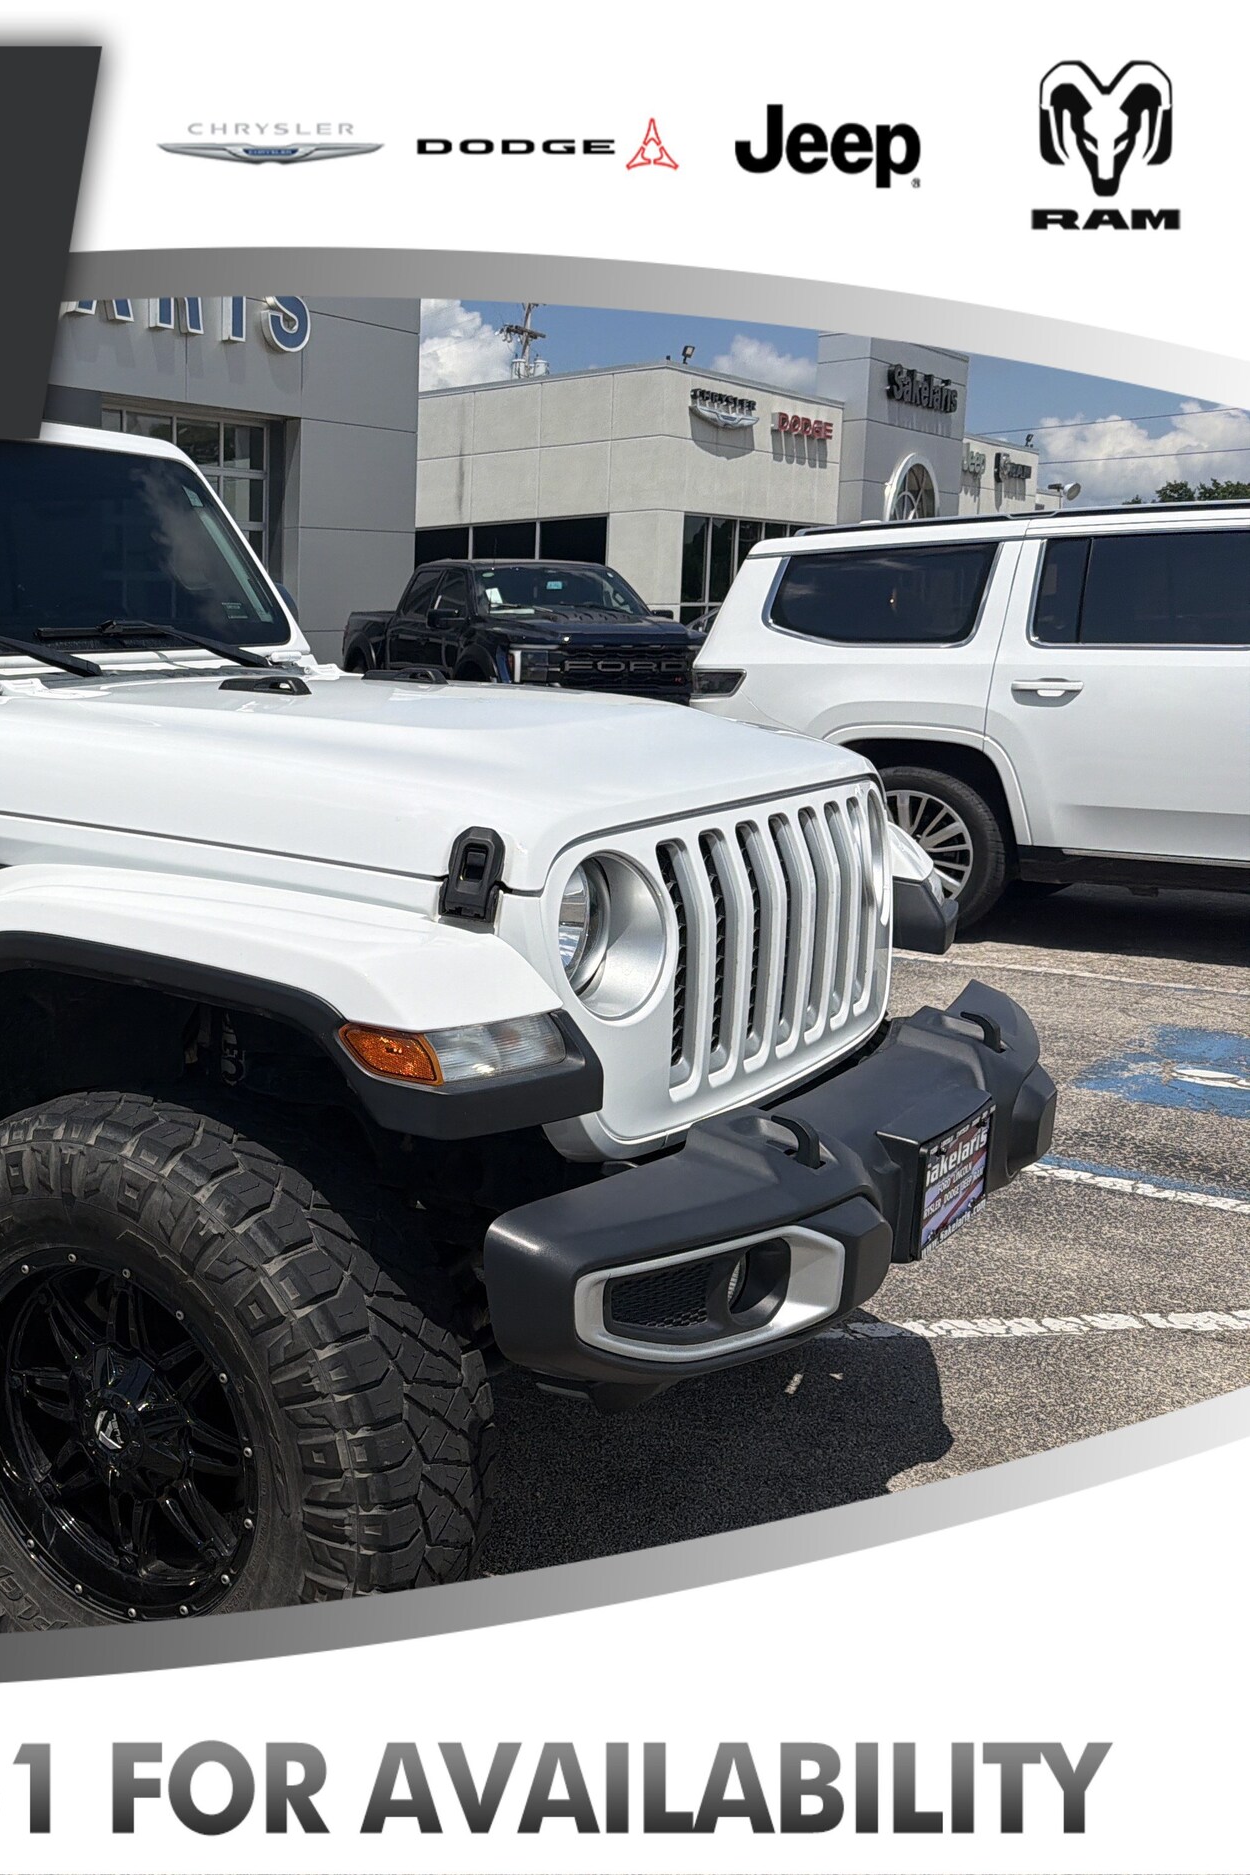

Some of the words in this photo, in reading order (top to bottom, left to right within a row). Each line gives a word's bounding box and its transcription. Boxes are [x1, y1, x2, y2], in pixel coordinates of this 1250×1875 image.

[887, 364, 958, 413] Sakelaris
[776, 411, 834, 440] DODGE
[962, 442, 987, 475] Jeep
[564, 660, 687, 673] FORD
